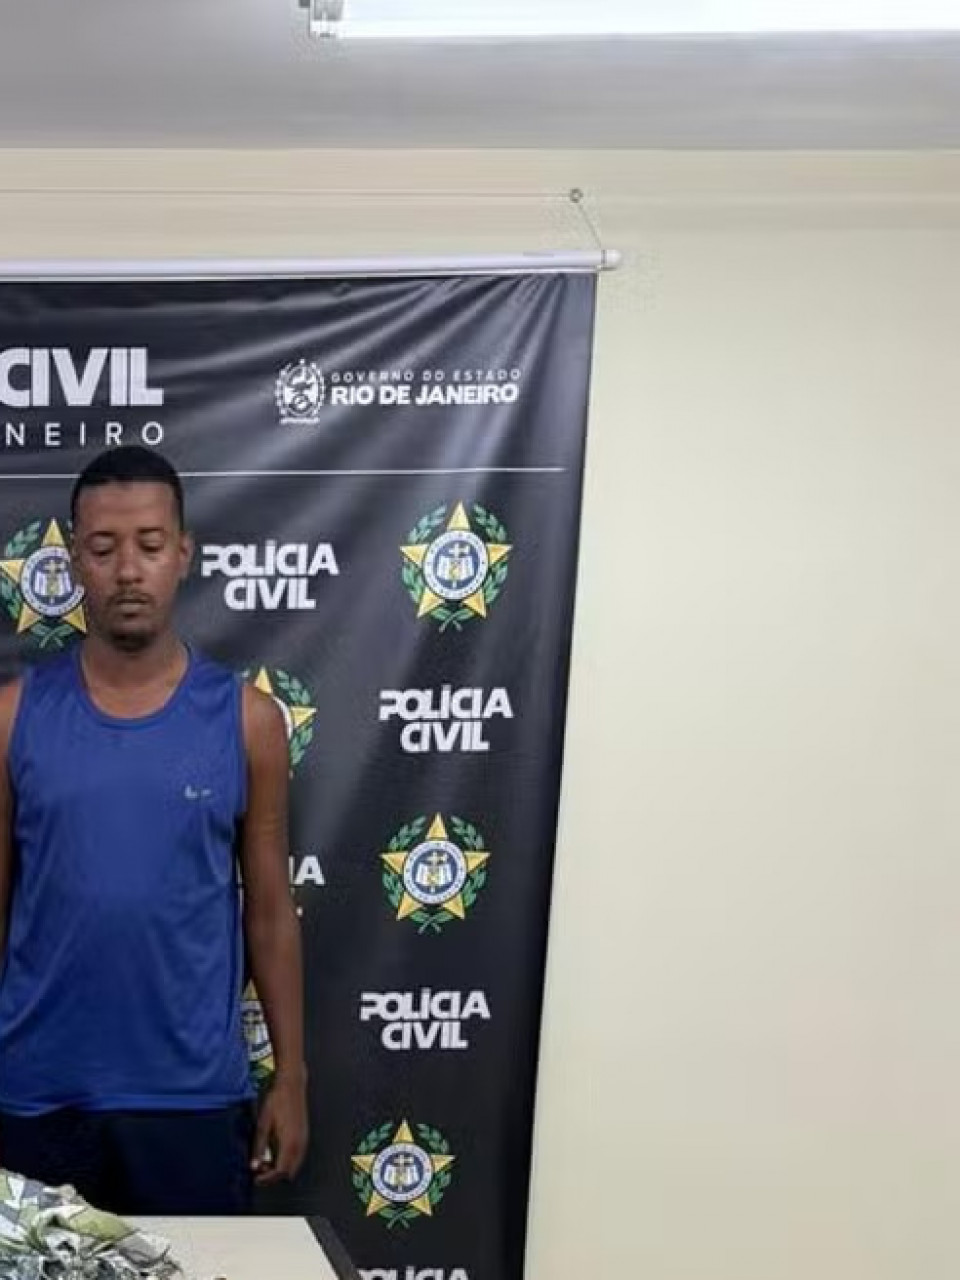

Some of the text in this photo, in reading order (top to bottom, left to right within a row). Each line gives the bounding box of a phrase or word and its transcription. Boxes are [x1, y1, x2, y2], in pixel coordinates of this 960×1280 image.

[331, 369, 521, 383] GOVERNO DO ESTADO
[331, 383, 519, 405] RIO DE JANEIRO
[201, 540, 339, 577] POLÍCIA
[224, 575, 316, 610] CIVIL
[379, 684, 514, 720] POLÍCIA
[400, 717, 490, 753] CIVIL
[360, 987, 491, 1020] POLÍCIA
[381, 1019, 468, 1051] CIVIL
